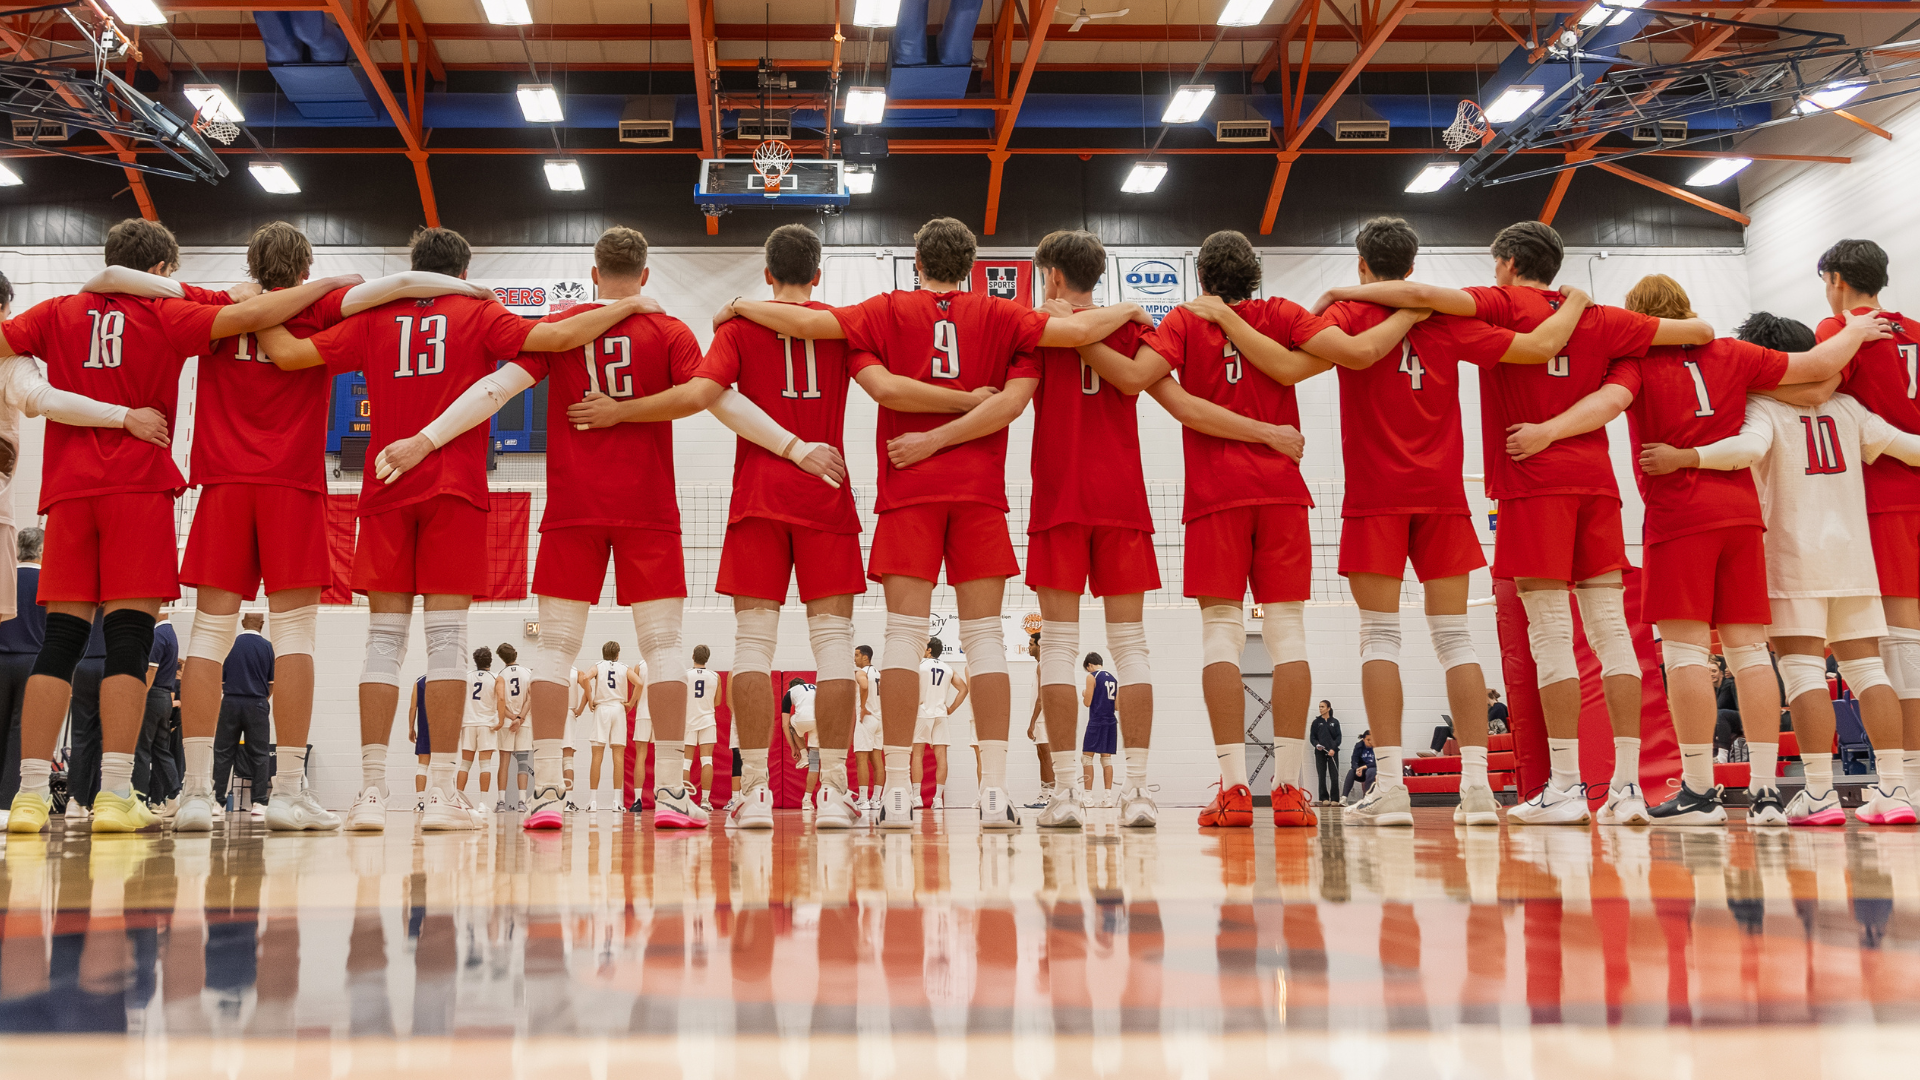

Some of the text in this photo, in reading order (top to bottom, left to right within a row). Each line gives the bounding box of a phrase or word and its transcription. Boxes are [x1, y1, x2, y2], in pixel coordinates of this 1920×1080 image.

[1126, 273, 1178, 284] OUA
[83, 309, 125, 369] 18
[393, 314, 448, 378] 13
[777, 333, 821, 399] 11
[931, 319, 960, 379] 9
[1398, 336, 1426, 390] 4
[584, 336, 634, 398] 12
[1684, 361, 1715, 417] 1
[1897, 343, 1919, 400] 7
[1799, 415, 1847, 475] 10
[472, 682, 483, 700] 2
[510, 678, 520, 696] 3
[607, 670, 616, 689] 5
[694, 680, 705, 698] 9
[931, 668, 944, 686] 17
[1105, 681, 1116, 700] 12
